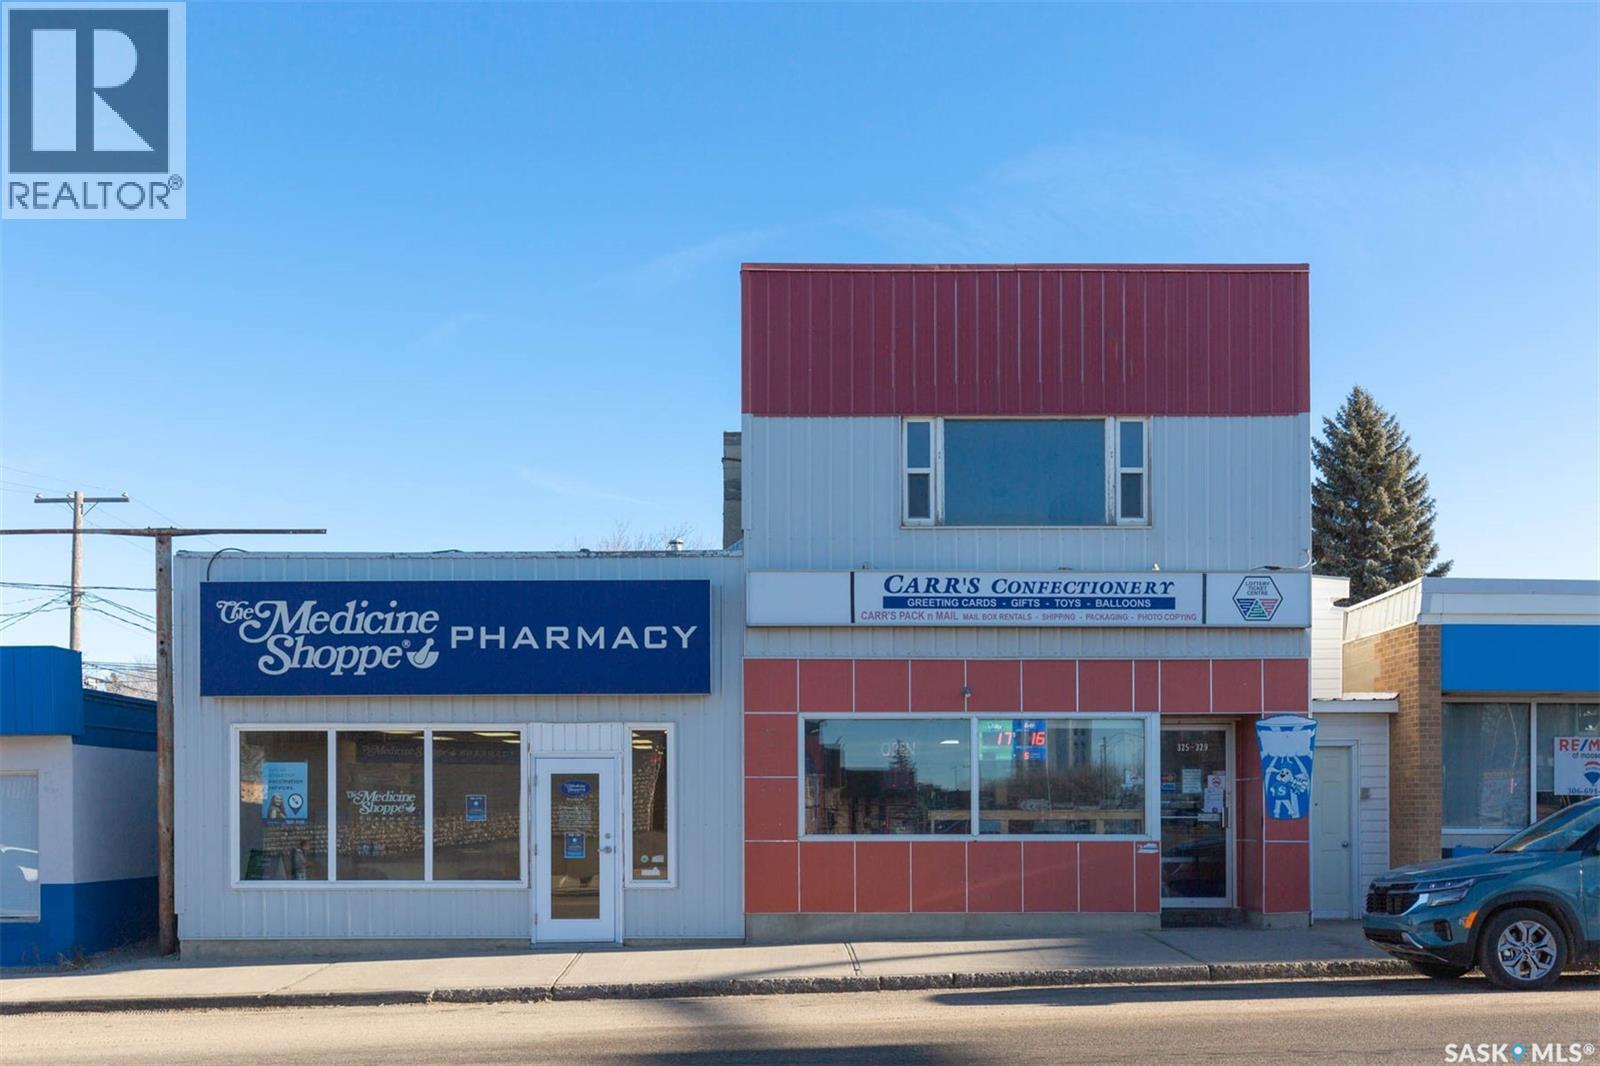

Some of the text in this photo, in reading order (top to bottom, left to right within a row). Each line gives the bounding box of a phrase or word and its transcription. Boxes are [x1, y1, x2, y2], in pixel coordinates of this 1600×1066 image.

[884, 574, 1175, 595] CARR'S CONFECTIONERY
[907, 598, 1151, 608] GREETING CARDS GIFTS TOYS BALLOONS
[216, 600, 439, 643] The Medicine
[860, 611, 897, 621] CARR'S
[900, 611, 925, 621] PACK
[936, 611, 958, 621] MAIL
[962, 613, 979, 621] MAIL
[982, 613, 998, 621] BOX
[1000, 613, 1032, 621] RENTALS
[1042, 613, 1076, 621] SHIPPING
[1085, 613, 1128, 621] PACKAGING
[1137, 613, 1162, 621] PHOTO
[1163, 613, 1197, 621] COPYING
[450, 625, 698, 649] PHARMACY
[997, 731, 1012, 746] 17
[1031, 731, 1046, 746] 16
[1559, 738, 1600, 752] RE/M
[353, 790, 416, 805] Medicine
